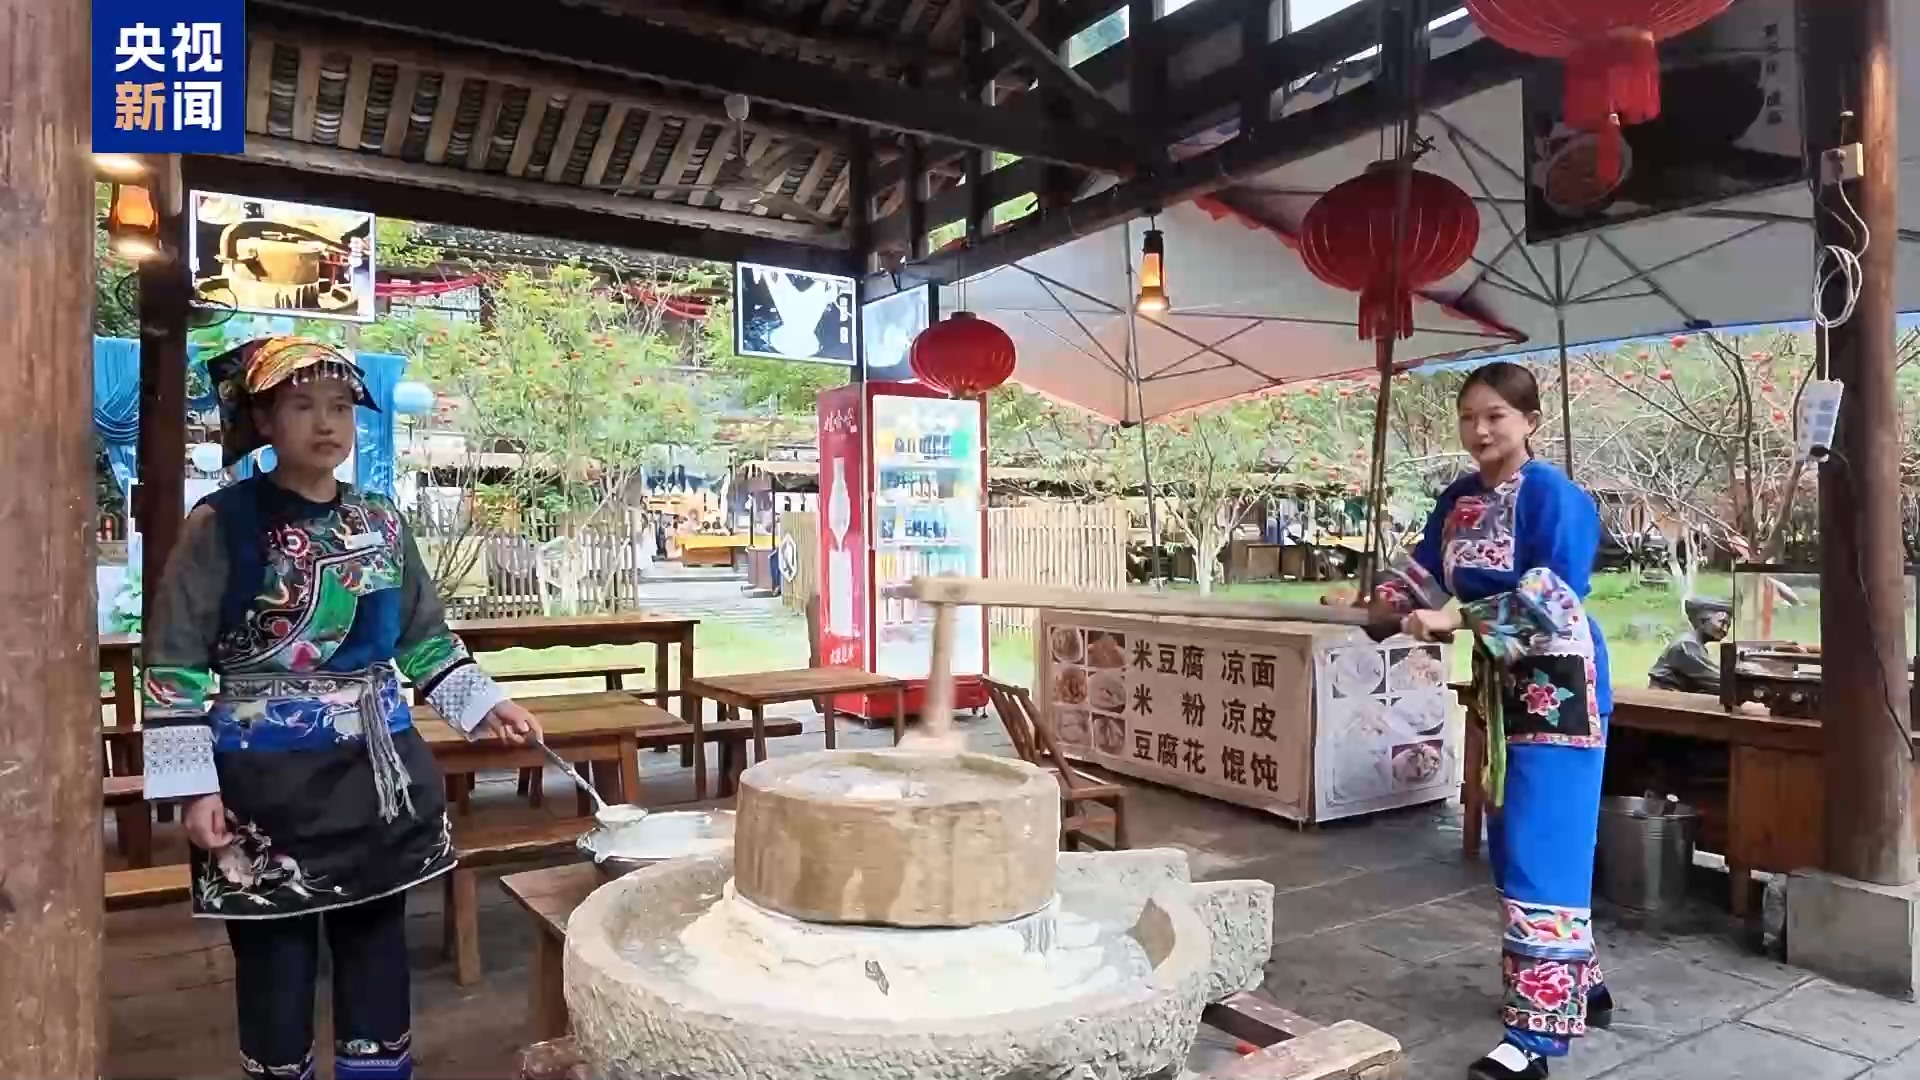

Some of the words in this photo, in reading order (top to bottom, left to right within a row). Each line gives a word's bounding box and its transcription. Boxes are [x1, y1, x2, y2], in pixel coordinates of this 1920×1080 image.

[1132, 639, 1205, 681] 米豆腐
[1221, 650, 1277, 691] 凉面
[1221, 698, 1278, 742] 凉皮
[1132, 729, 1206, 775] 豆腐花
[1221, 745, 1279, 792] 馄饨
